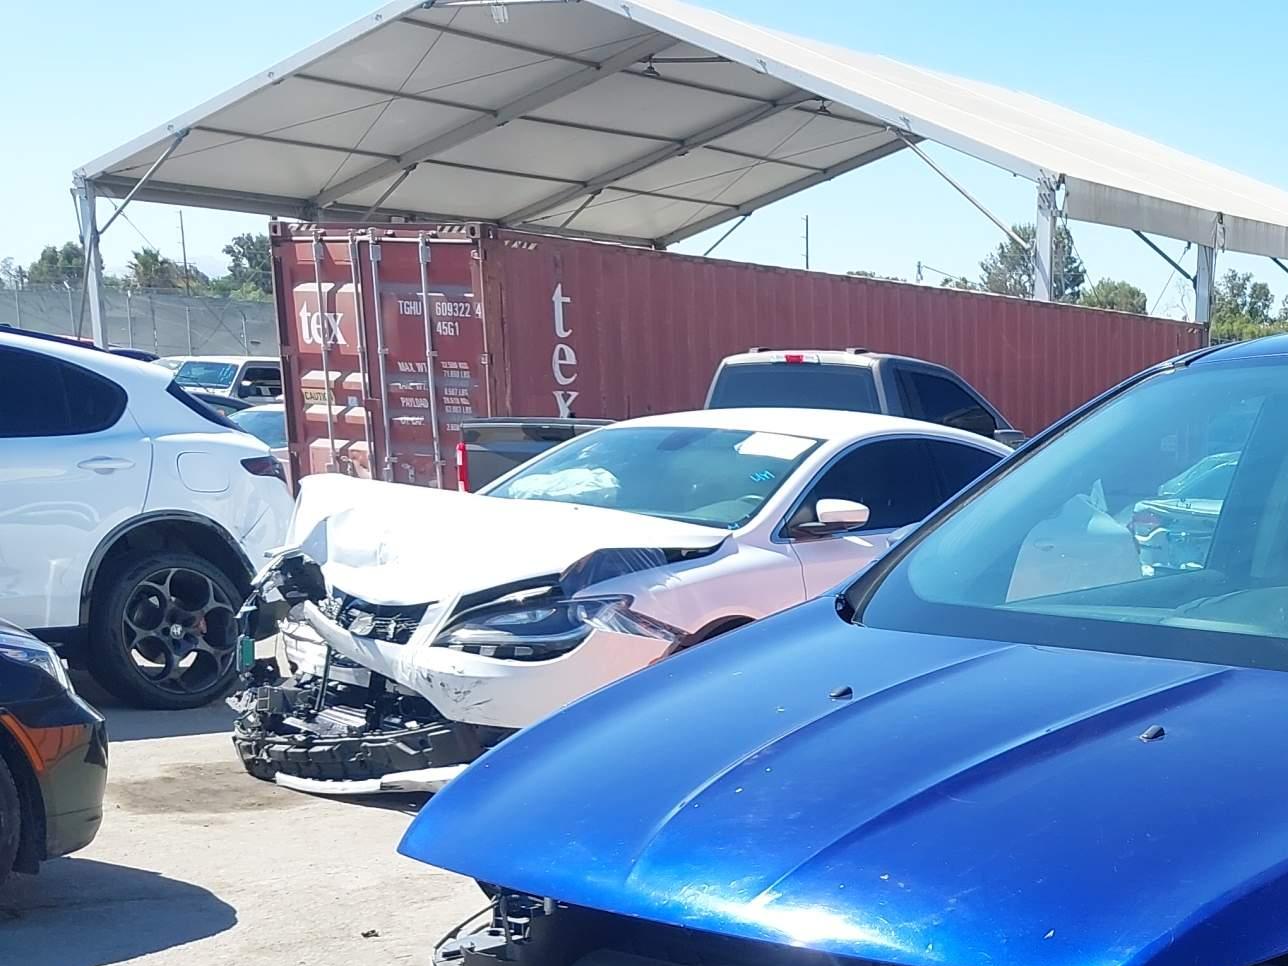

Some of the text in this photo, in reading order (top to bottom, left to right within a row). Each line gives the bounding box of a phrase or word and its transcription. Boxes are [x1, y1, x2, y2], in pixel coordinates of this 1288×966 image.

[299, 300, 347, 345] tex
[398, 300, 422, 315] TGHU
[435, 302, 471, 317] 609322
[436, 321, 459, 336] 45G1
[552, 283, 579, 418] tex
